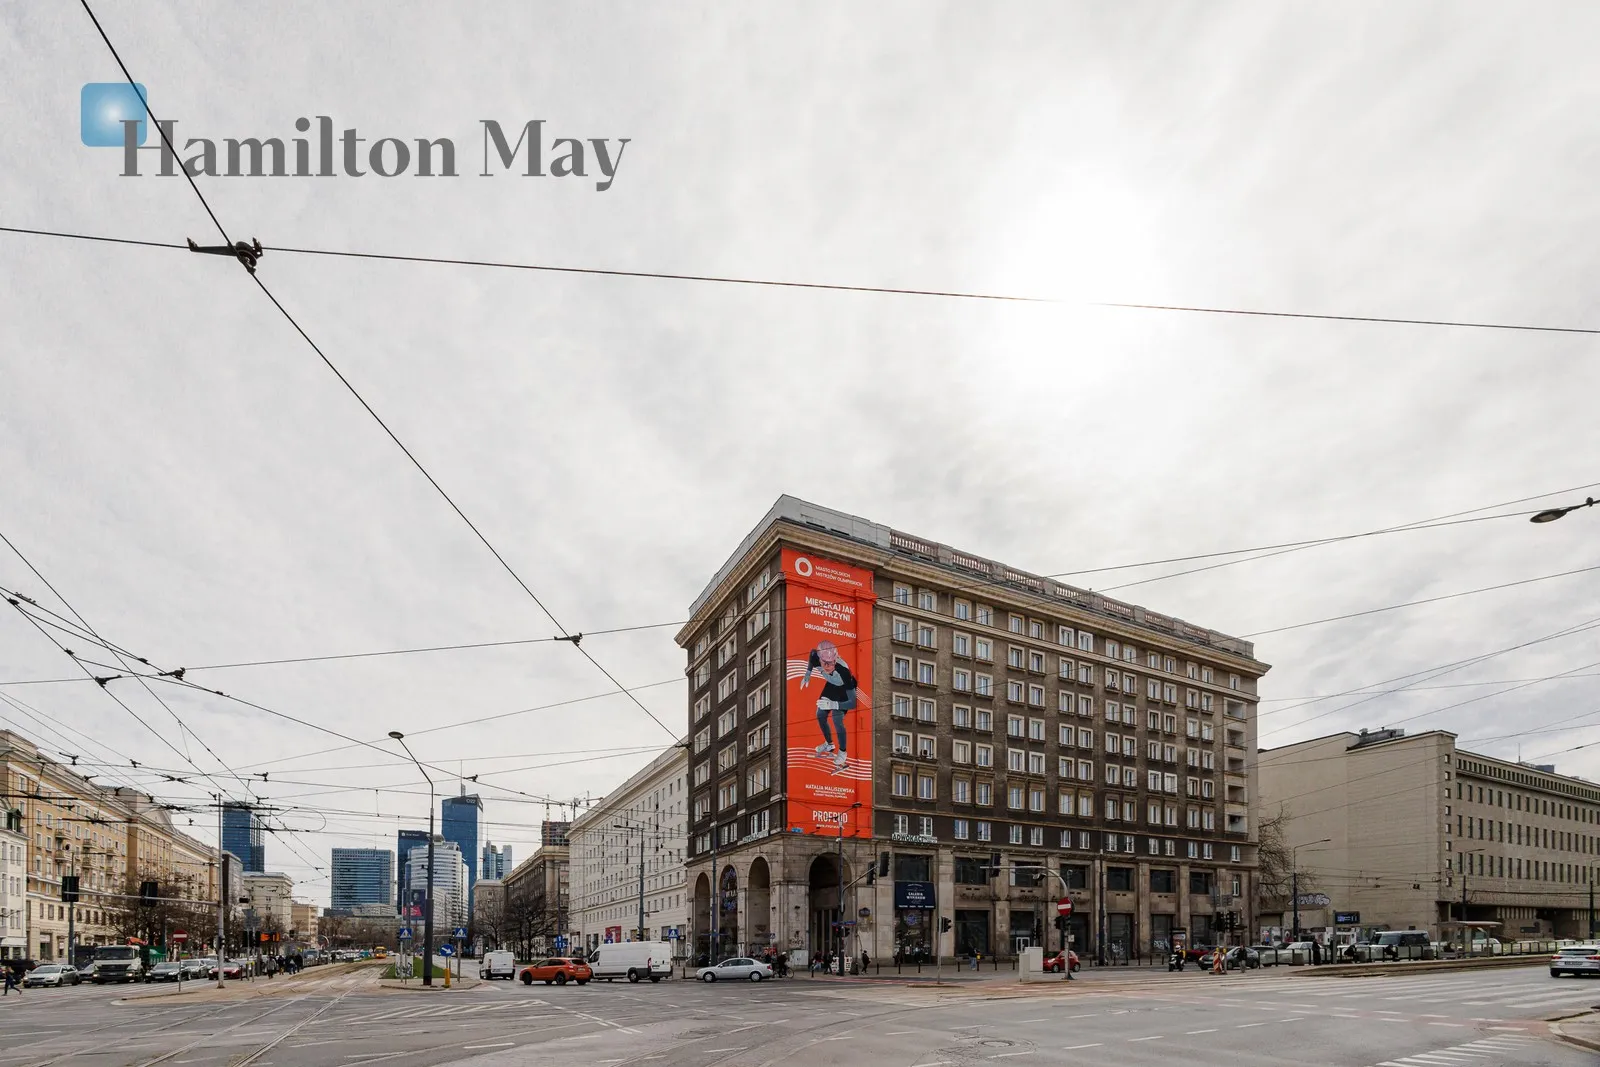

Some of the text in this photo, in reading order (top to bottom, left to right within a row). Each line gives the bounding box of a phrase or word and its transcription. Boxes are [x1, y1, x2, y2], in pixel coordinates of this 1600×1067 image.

[805, 596, 855, 615] MIESZKAJ JAK
[810, 606, 851, 622] MISTRZYNI
[804, 623, 856, 639] DRUGIEGO BUDYNKU
[823, 620, 839, 629] START
[812, 810, 848, 824] PROFBUD
